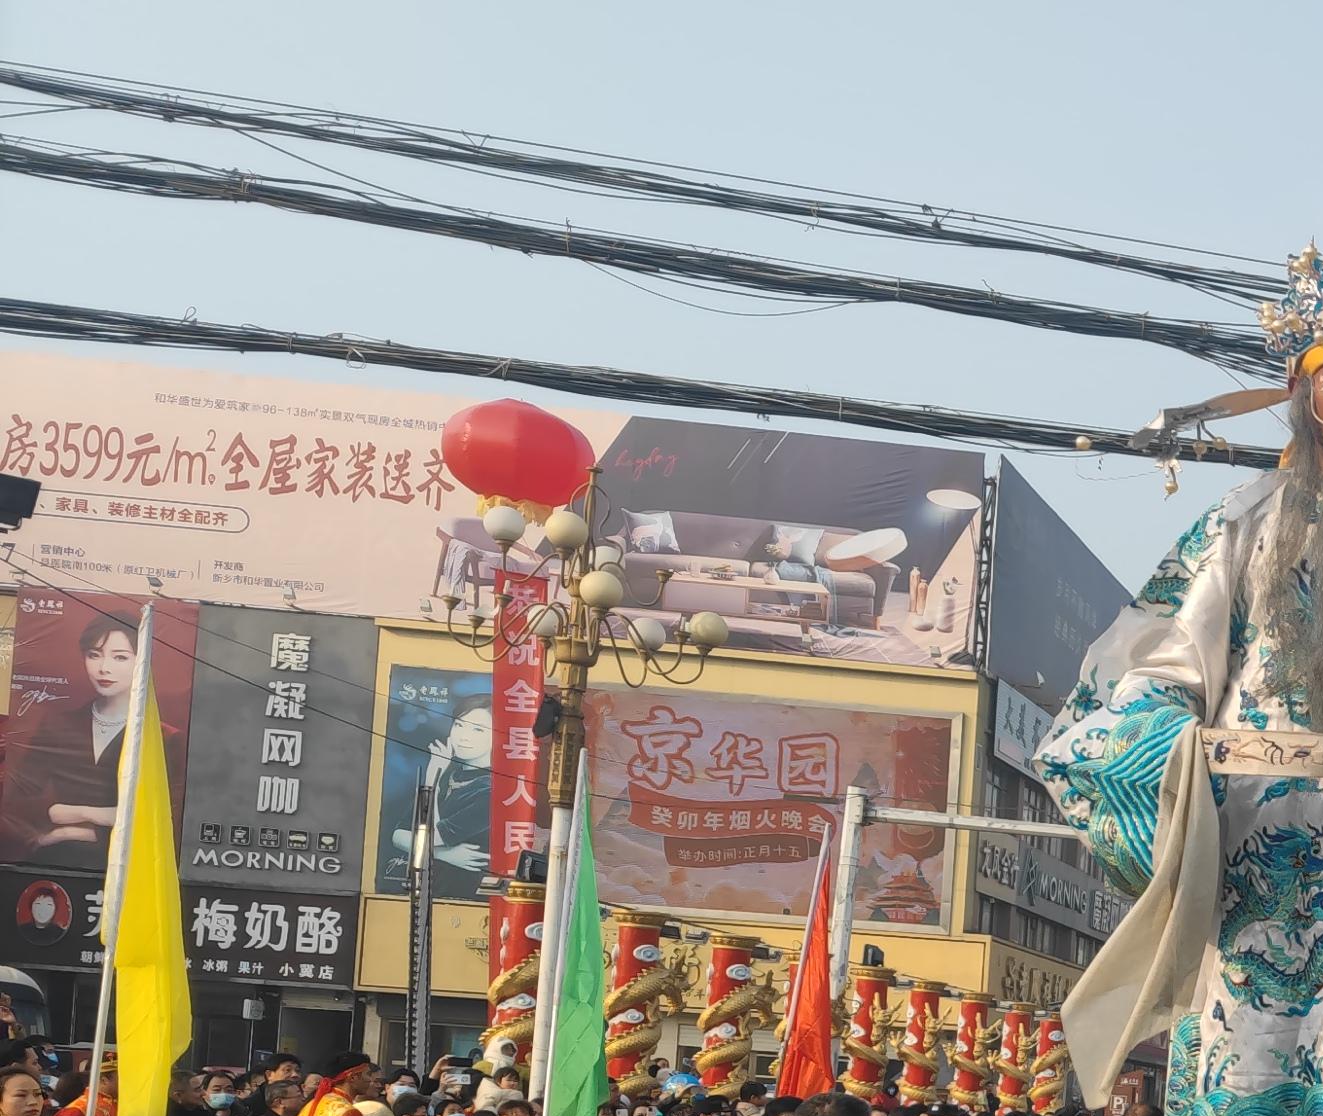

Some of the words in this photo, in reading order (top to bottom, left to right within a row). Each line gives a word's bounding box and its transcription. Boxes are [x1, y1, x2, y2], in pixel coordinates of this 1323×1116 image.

[257, 632, 312, 815] 魔凝网咖
[621, 705, 838, 799] 京华园
[651, 805, 830, 834] 癸卯年烟火晚会
[192, 847, 342, 874] MORNING
[1039, 872, 1087, 914] MORNING
